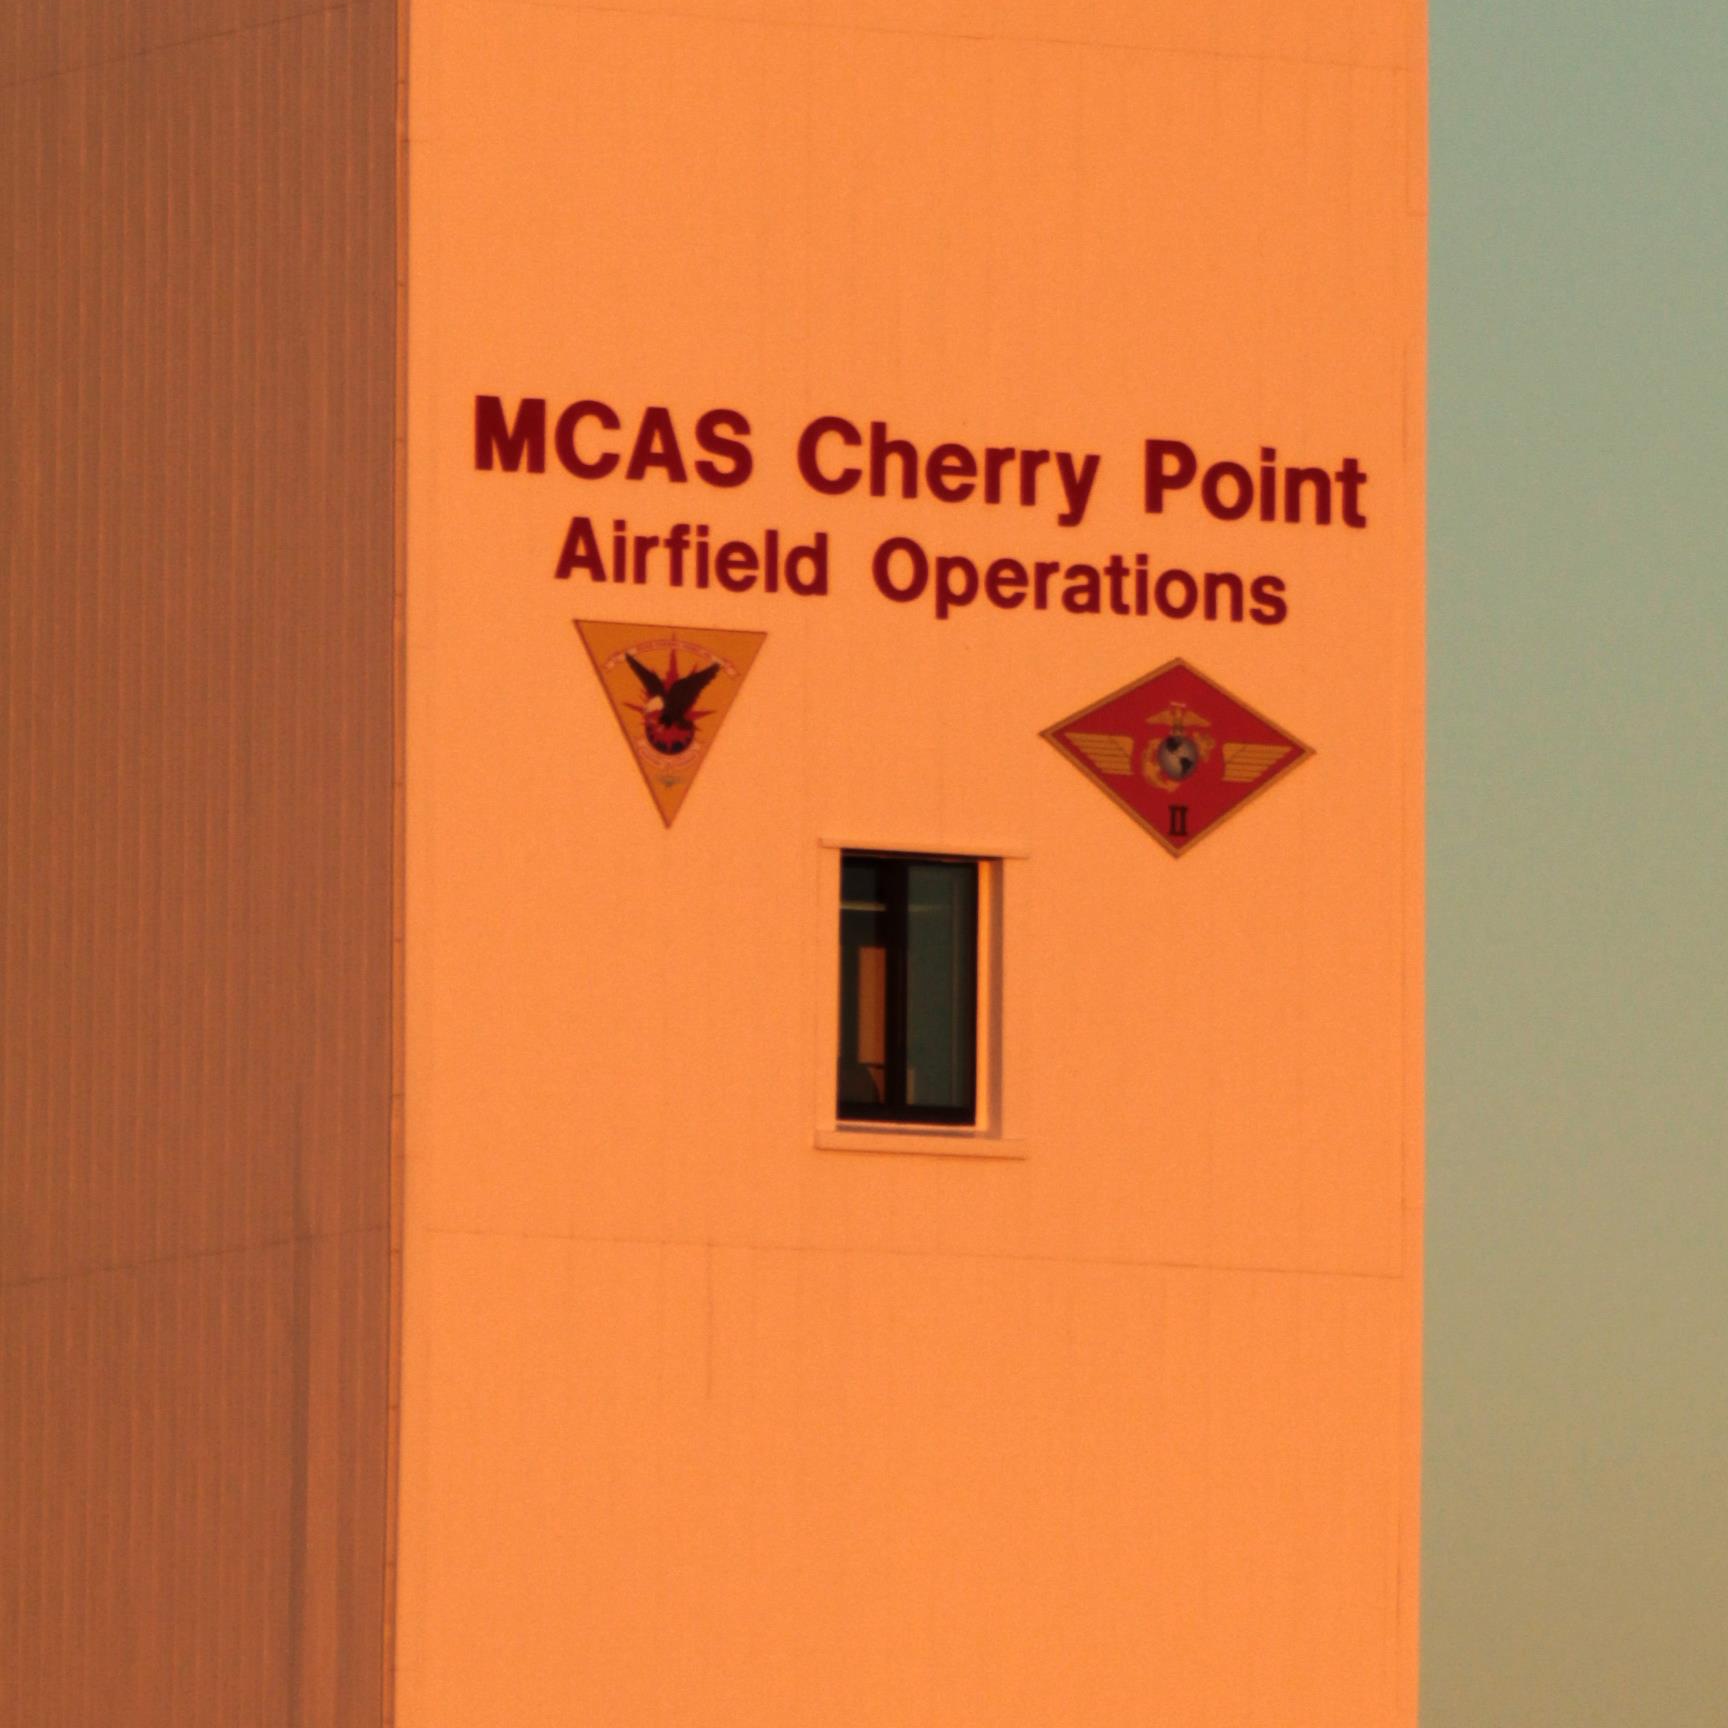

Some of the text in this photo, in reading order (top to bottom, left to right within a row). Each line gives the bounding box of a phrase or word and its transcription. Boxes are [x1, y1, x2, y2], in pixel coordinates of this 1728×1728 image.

[474, 394, 1368, 529] MCAS Cherry Point
[554, 516, 1288, 626] Airfield Operations
